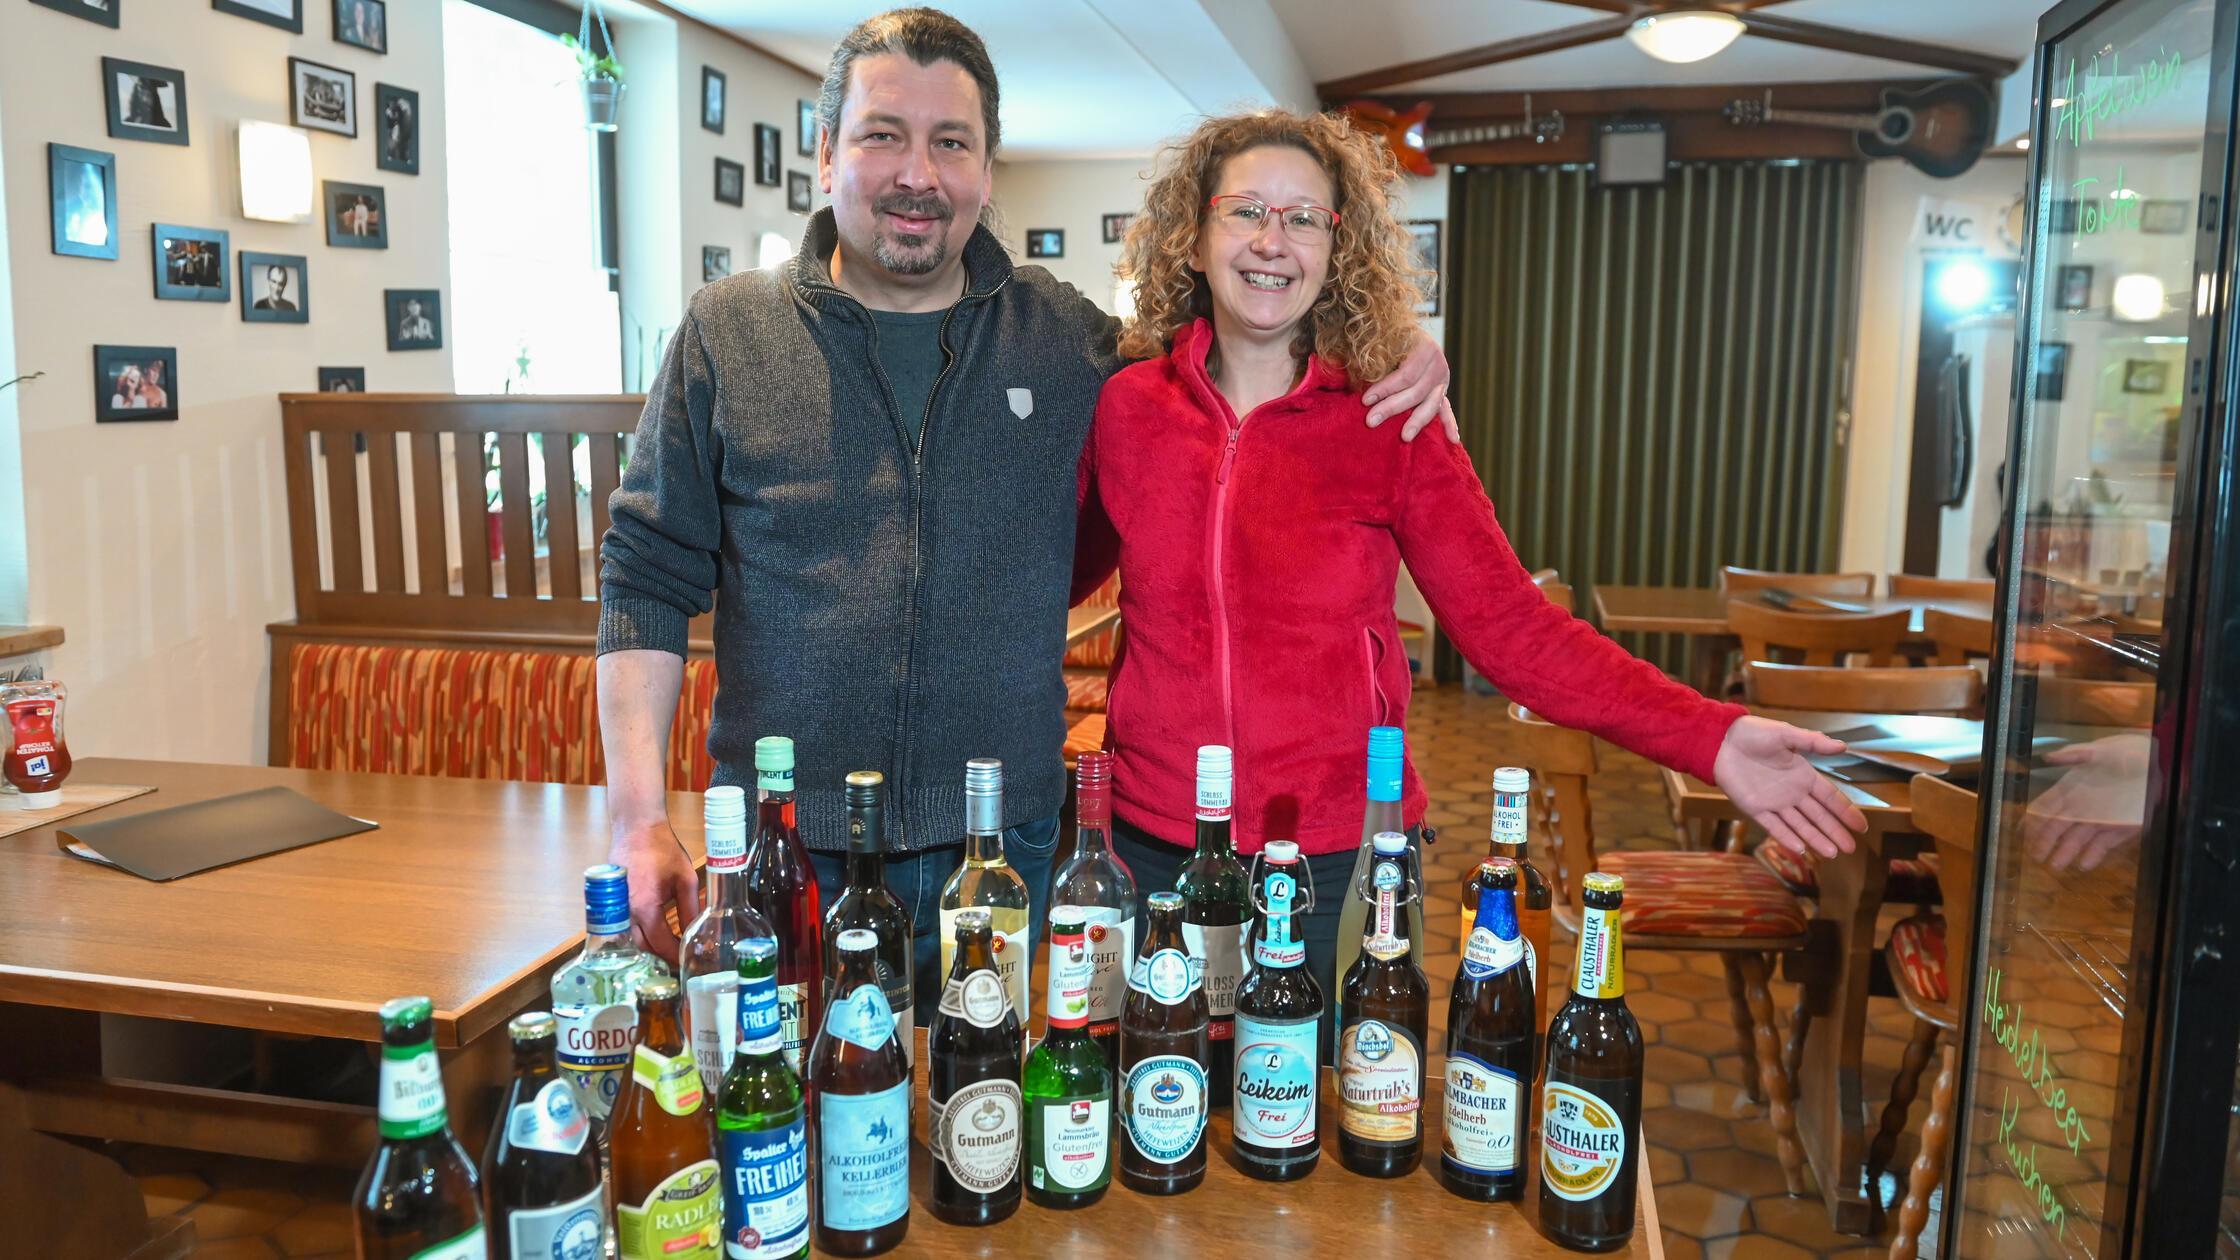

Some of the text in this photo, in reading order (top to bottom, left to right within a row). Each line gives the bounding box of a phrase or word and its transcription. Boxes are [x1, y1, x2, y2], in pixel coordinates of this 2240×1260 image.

[2055, 44, 2181, 147] Apfelwein
[1926, 213, 1974, 240] WC
[31, 758, 46, 772] ja!
[1498, 820, 1513, 829] FREI
[1086, 951, 1118, 964] IGHT
[1581, 916, 1600, 990] CLAUSTHALER
[1608, 919, 1618, 989] NATURRADLER
[779, 1000, 805, 1021] ENT
[568, 1026, 638, 1050] GORDO
[1209, 1023, 1225, 1037] frei
[697, 1049, 734, 1068] SCHLO
[1152, 1060, 1186, 1069] GUTMANN
[1237, 1071, 1313, 1101] Leikeim
[1343, 1080, 1411, 1101] Naturtrüb's
[1138, 1103, 1196, 1119] Gutmann
[1258, 1109, 1288, 1123] Frei
[1379, 1100, 1420, 1114] Alkoholfrei
[1449, 1103, 1487, 1126] Edelherb
[958, 1128, 1016, 1147] Gutmann
[1058, 1130, 1100, 1141] Lammsbräu
[1545, 1116, 1620, 1153] AUSTHALER
[1053, 1138, 1103, 1153] Glutenfrei
[1999, 1086, 2065, 1242] Kuchen
